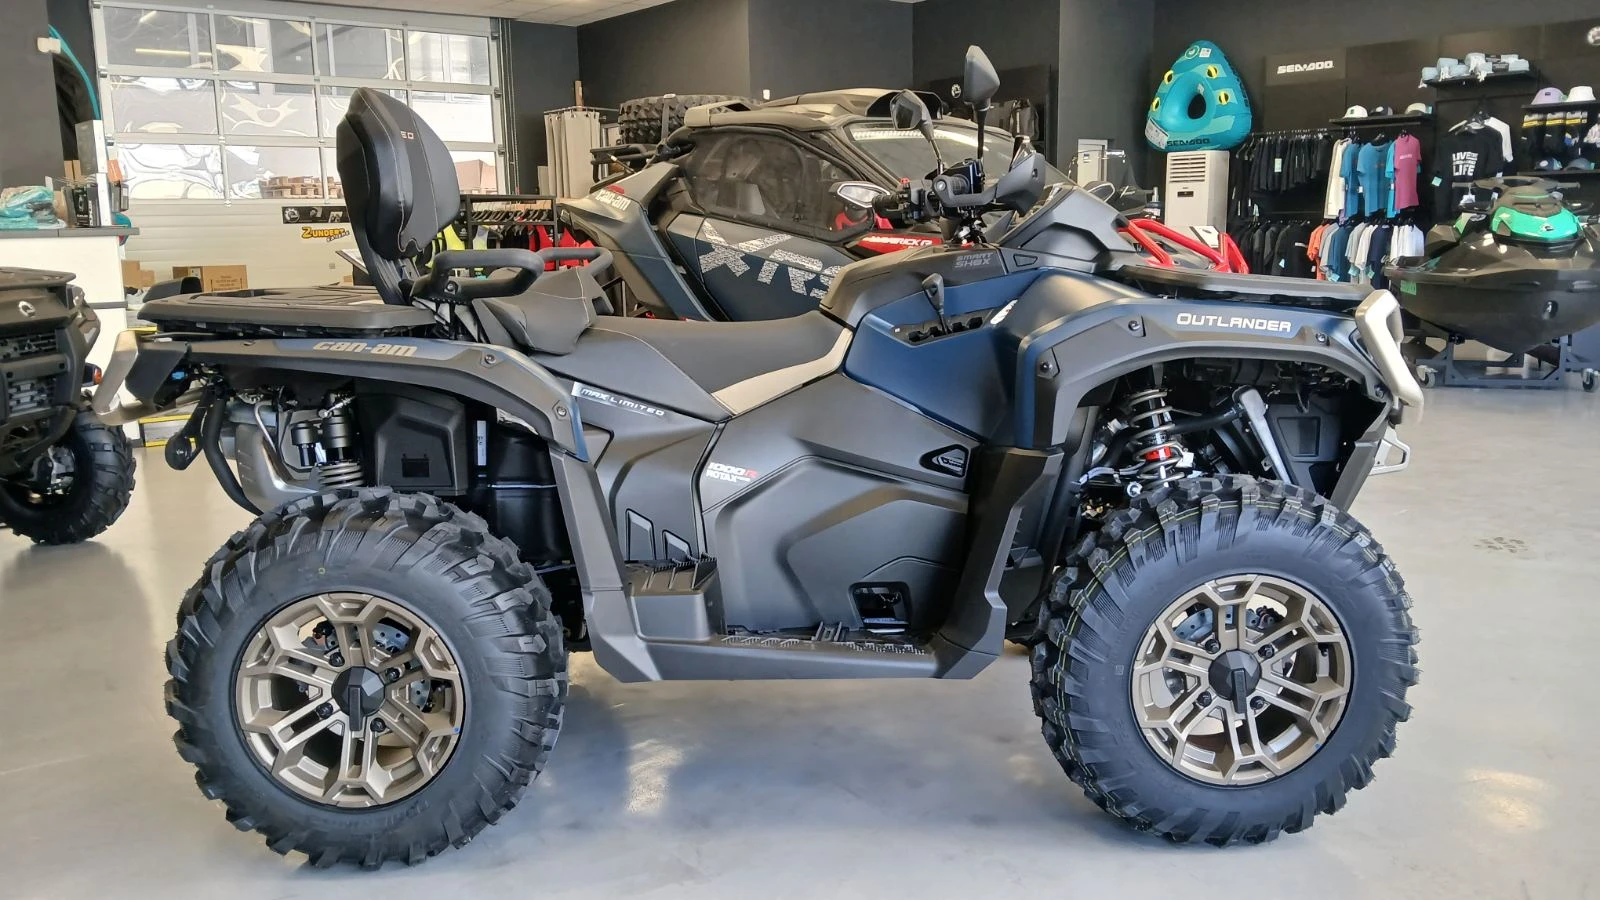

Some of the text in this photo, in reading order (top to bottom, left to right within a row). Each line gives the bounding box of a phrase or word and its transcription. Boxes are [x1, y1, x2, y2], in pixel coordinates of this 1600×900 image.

[1453, 163, 1476, 176] LIFE
[1176, 312, 1292, 333] OUTLANDER
[313, 341, 418, 357] can-am
[580, 387, 665, 417] MAX LIMITED
[706, 469, 737, 483] ROTAX
